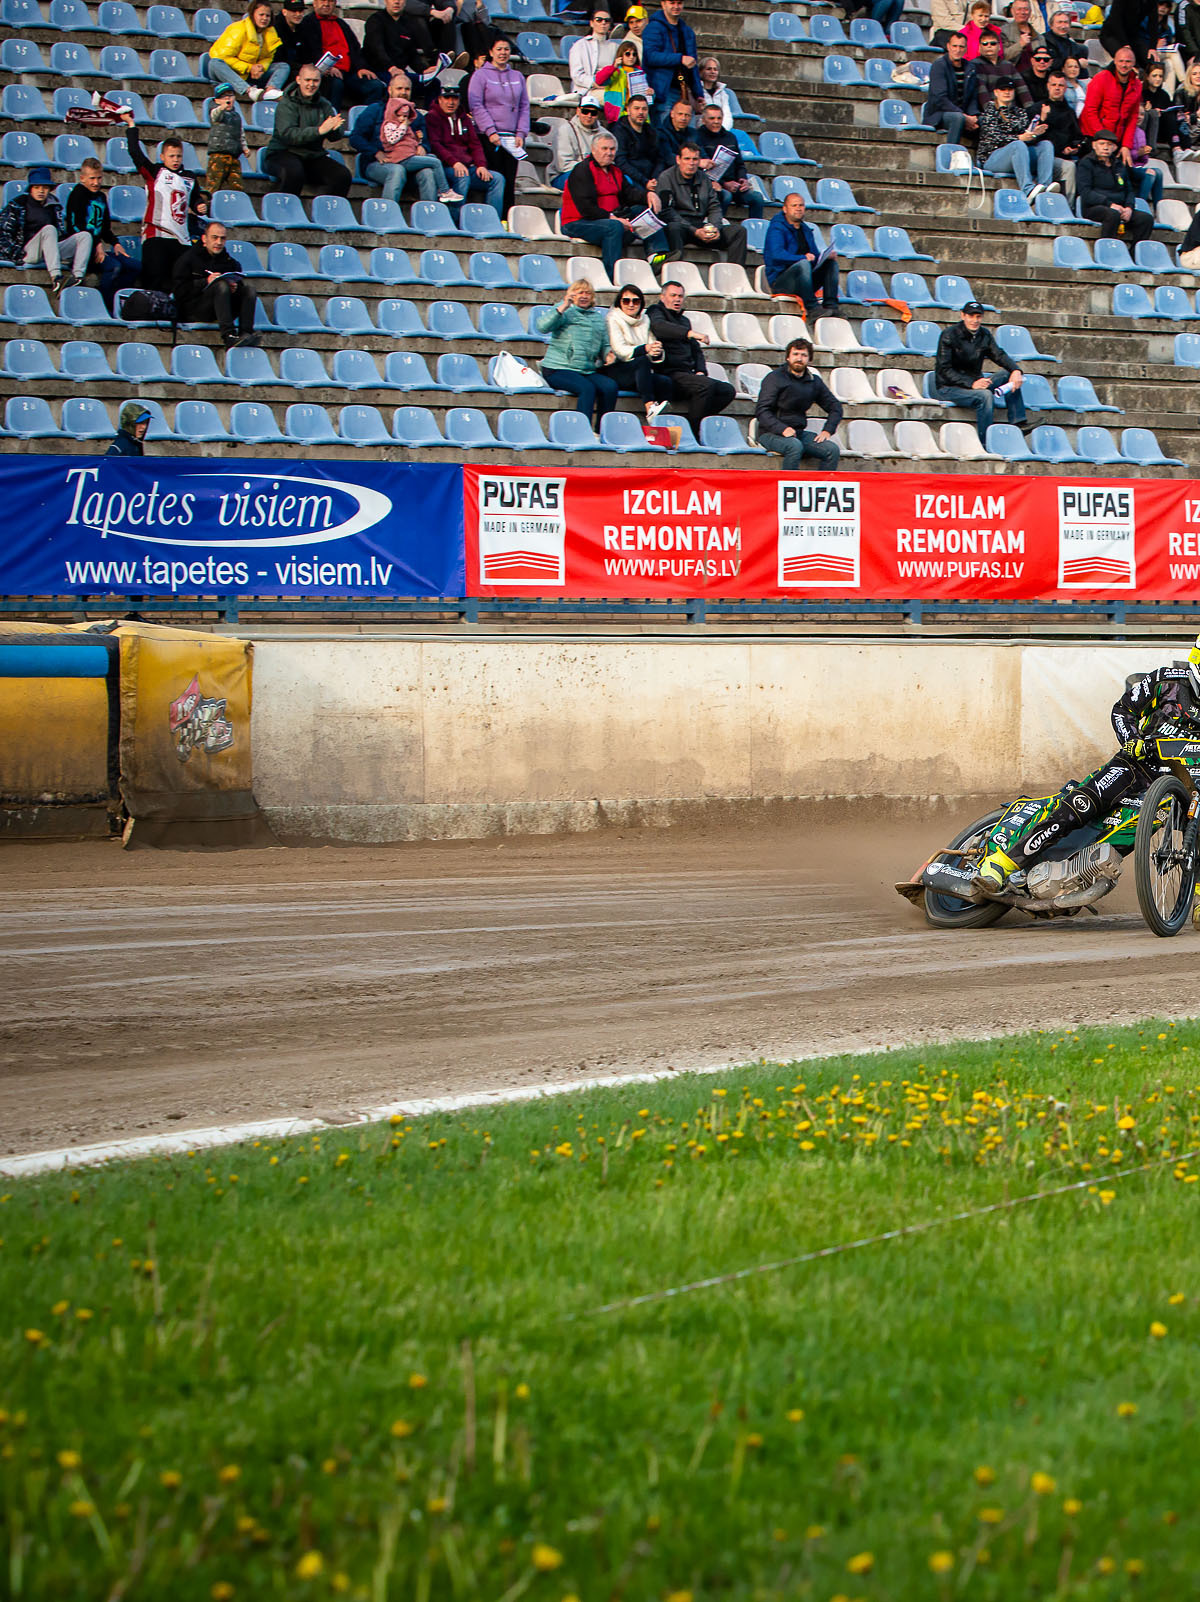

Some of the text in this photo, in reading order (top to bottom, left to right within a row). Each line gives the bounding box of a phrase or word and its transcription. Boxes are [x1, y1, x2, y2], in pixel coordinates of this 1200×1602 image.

[66, 468, 334, 538] Tapetes visiem
[484, 481, 560, 509] PUFAS
[623, 489, 722, 516] IZCILAM
[783, 487, 855, 513] PUFAS
[915, 494, 1006, 520] IZCILAM
[1063, 492, 1130, 518] PUFAS
[484, 521, 560, 534] MADE IN GERMANY
[603, 525, 742, 552] REMONTAM
[783, 525, 855, 537] MADE IN GERMANY
[1063, 529, 1131, 541] MADE IN GERMANY
[897, 528, 1025, 554] REMONTAM
[65, 555, 249, 592] www.tapetes
[275, 555, 393, 586] visiem.lv
[604, 558, 743, 577] WWW.PUFAS.LV
[897, 560, 1025, 579] WWW.PUFAS.LV
[1030, 823, 1061, 850] WIKO
